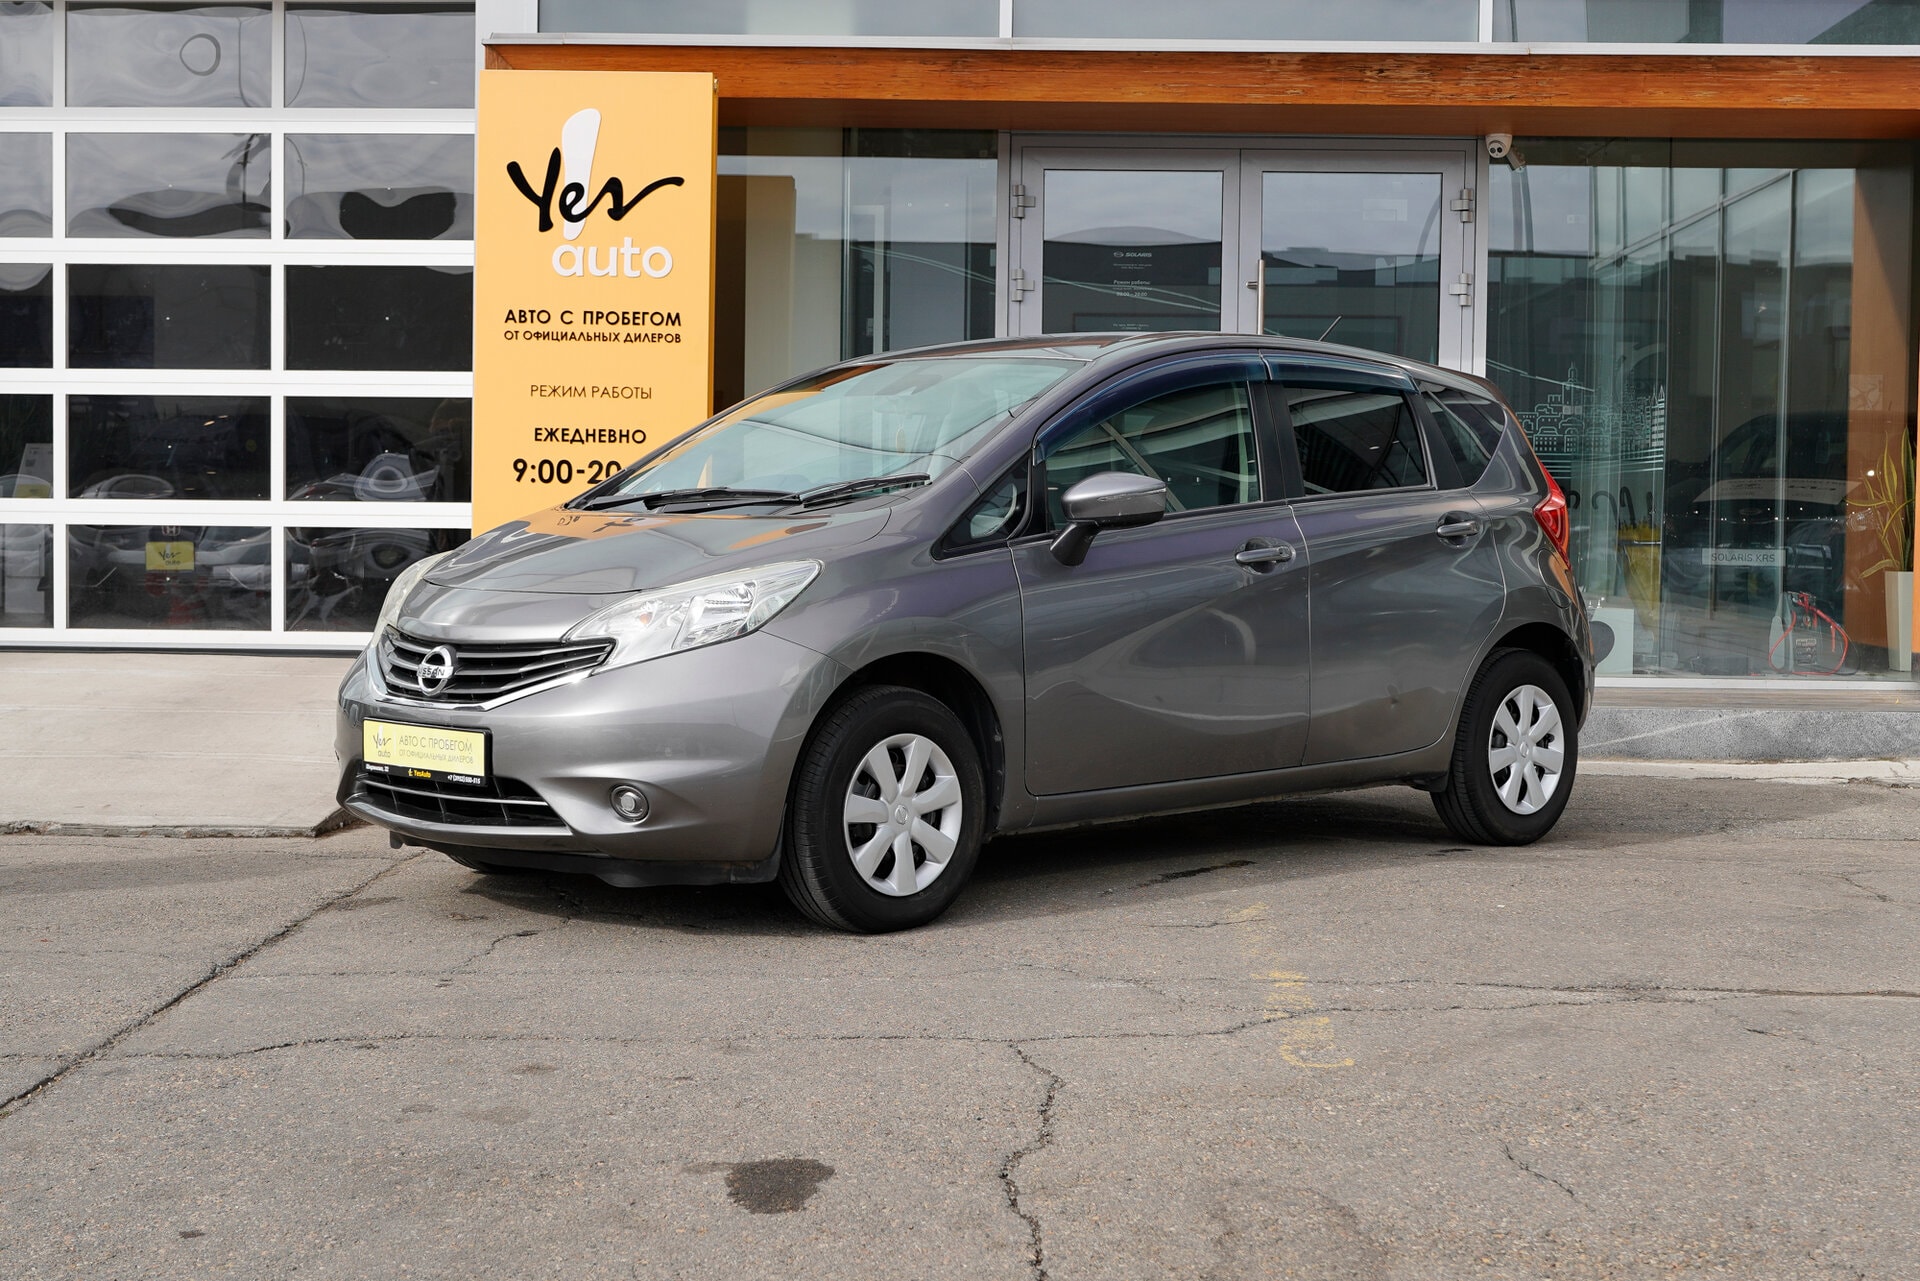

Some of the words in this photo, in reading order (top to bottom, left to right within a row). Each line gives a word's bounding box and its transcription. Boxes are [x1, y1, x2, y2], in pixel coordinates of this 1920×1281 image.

[551, 237, 674, 279] auto
[504, 308, 552, 325] АВТО
[559, 309, 575, 326] С
[582, 309, 682, 327] ПРОБЕГОМ
[503, 330, 521, 342] ОТ
[522, 330, 621, 344] ОФИЦИАЛЬНЫХ
[623, 331, 682, 344] ДИЛЕРОВ
[530, 384, 587, 399] РЕЖИМ
[592, 385, 652, 400] РАБОТЫ
[534, 427, 647, 445] ЕЖЕДНЕВНО
[1711, 553, 1753, 562] SOLARIS
[1755, 553, 1776, 563] XRS
[399, 735, 419, 747] АВТО
[428, 738, 473, 752] ПРОБЕГОМ
